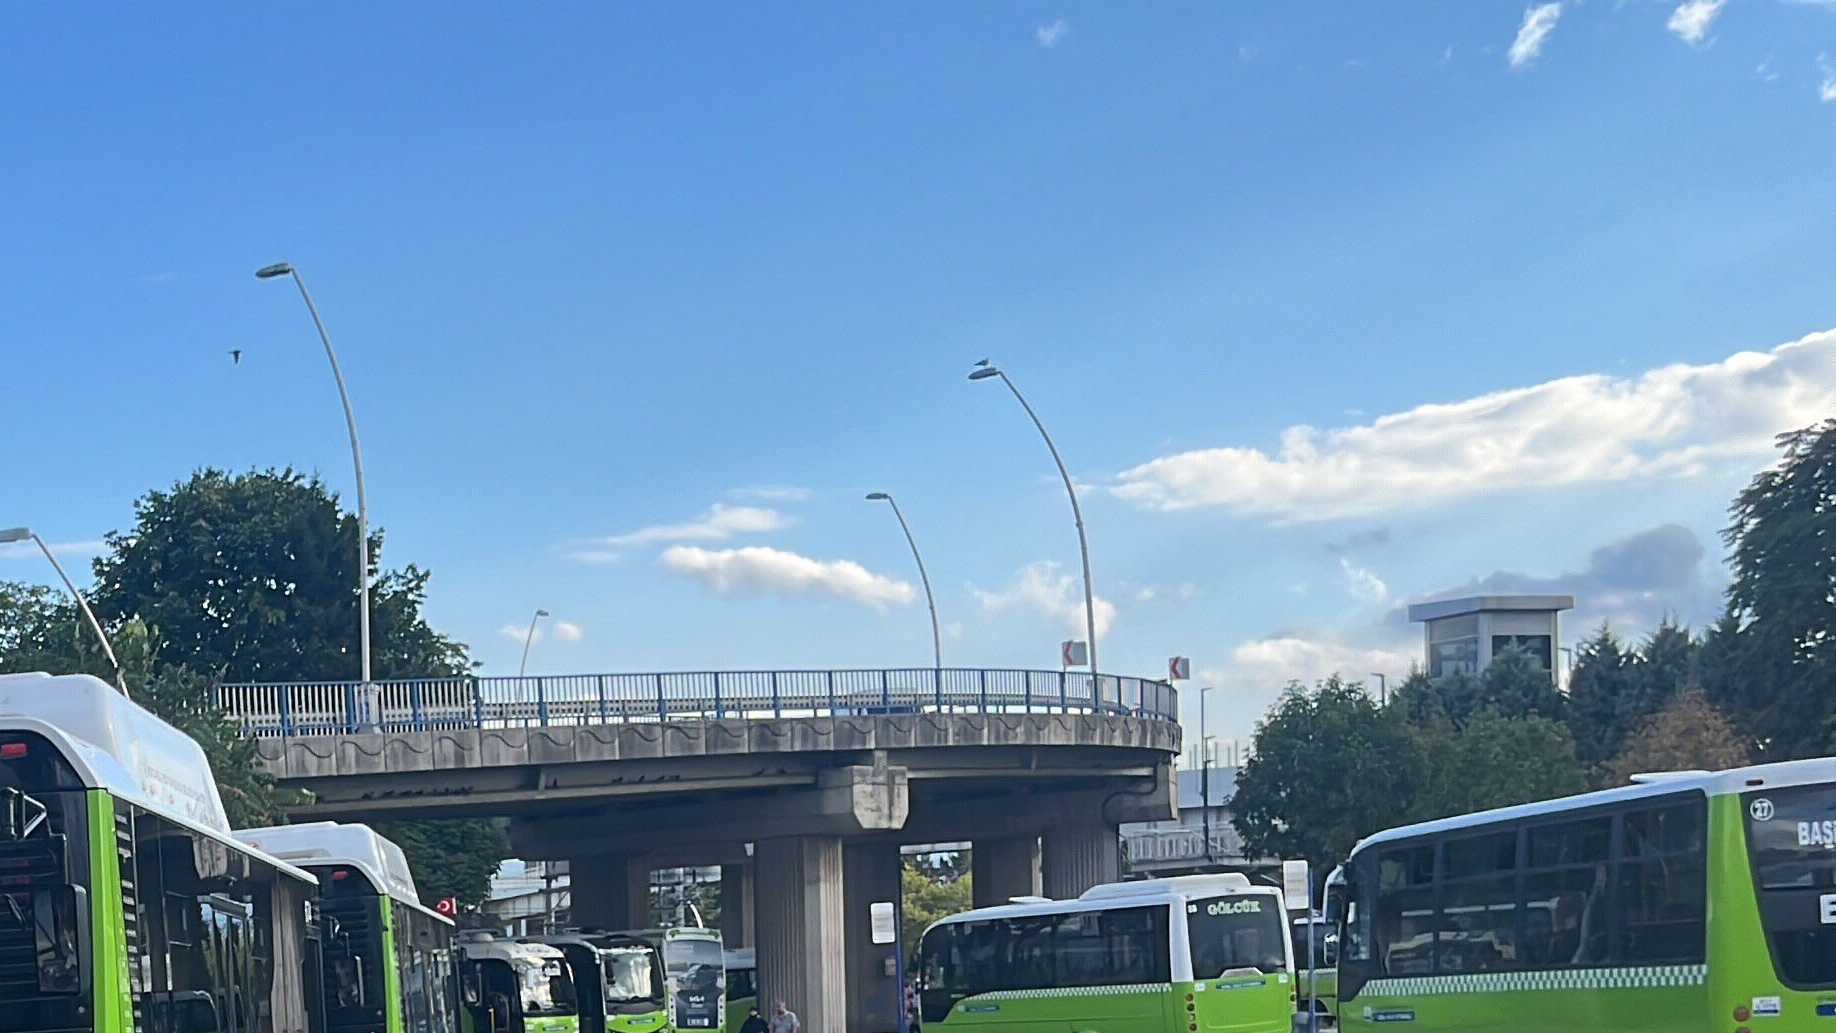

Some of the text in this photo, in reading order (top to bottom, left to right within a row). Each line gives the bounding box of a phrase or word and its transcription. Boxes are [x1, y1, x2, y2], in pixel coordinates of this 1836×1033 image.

[1754, 801, 1769, 818] 27
[1797, 820, 1836, 850] BAŞ
[1207, 899, 1261, 915] GÖLCÜK
